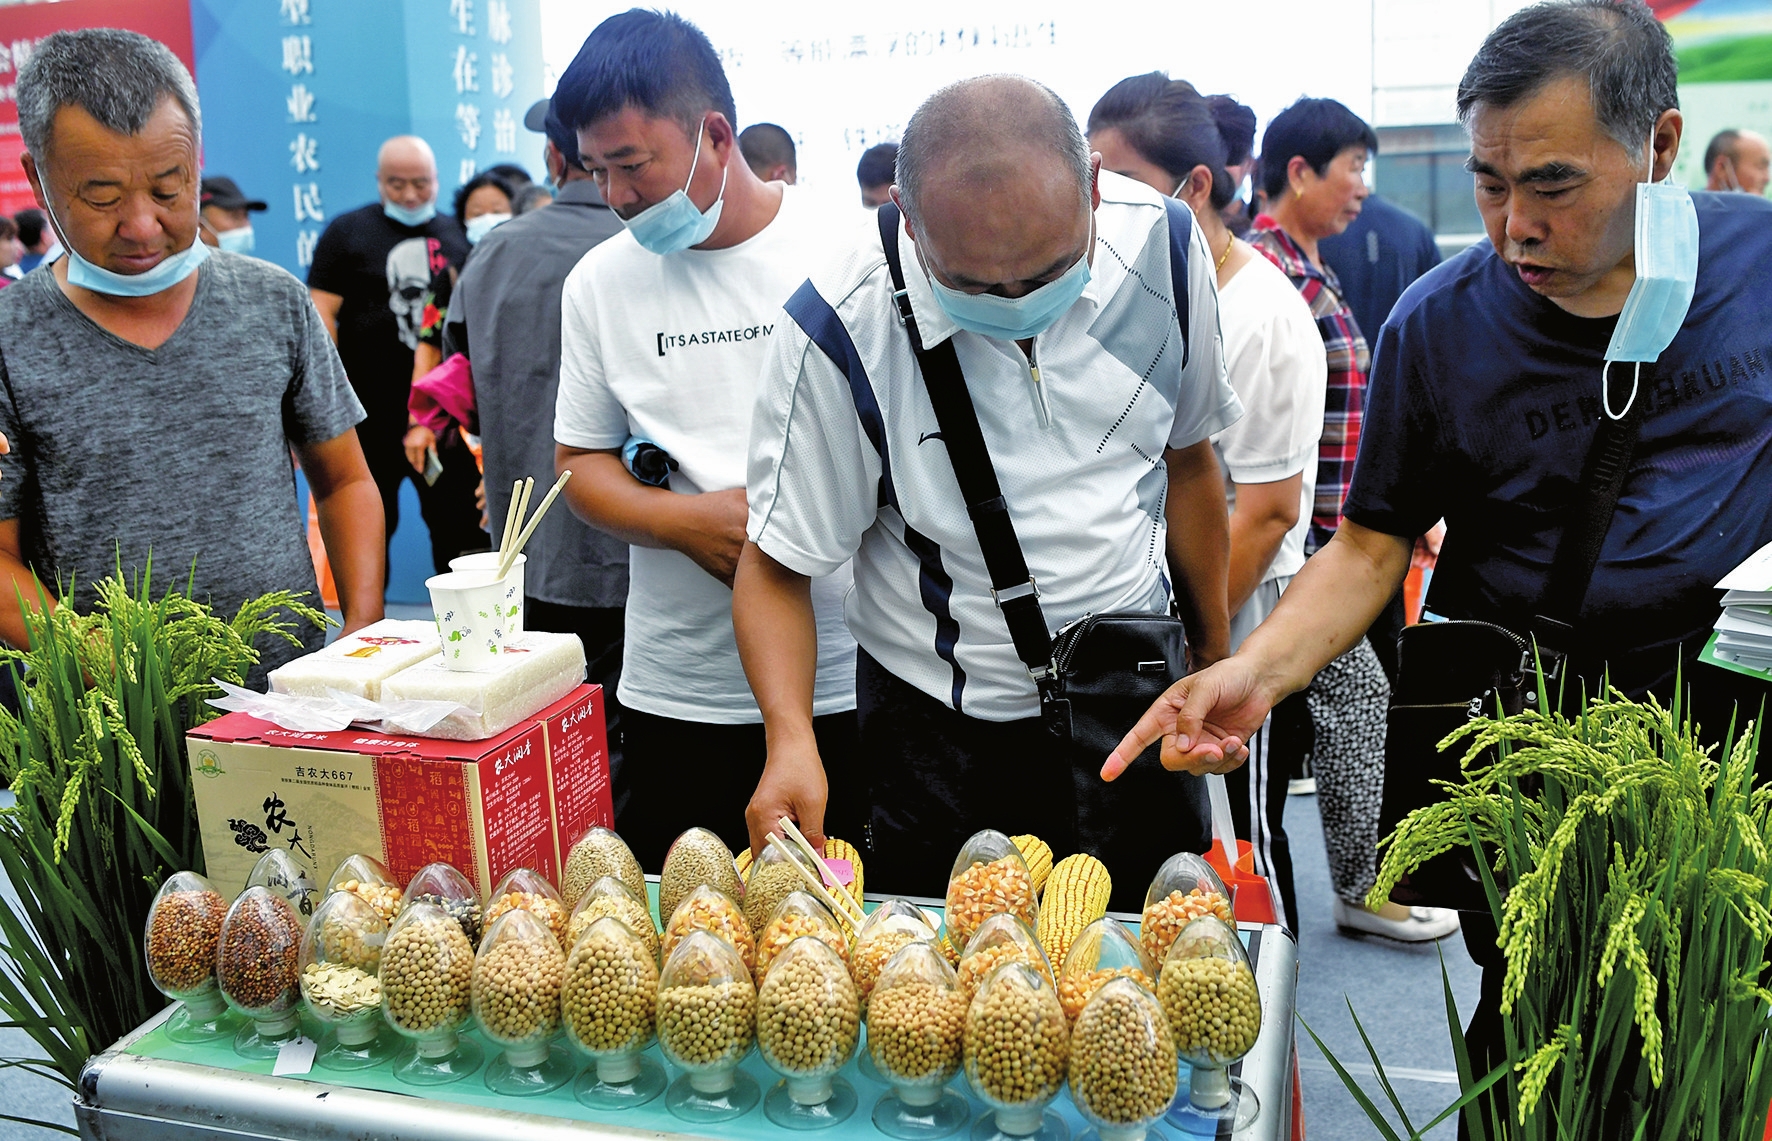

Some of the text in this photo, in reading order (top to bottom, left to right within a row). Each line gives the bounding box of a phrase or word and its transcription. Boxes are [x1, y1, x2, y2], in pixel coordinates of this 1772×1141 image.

[701, 329, 742, 344] STATE
[743, 326, 760, 340] OF
[295, 766, 353, 781] 吉农大667
